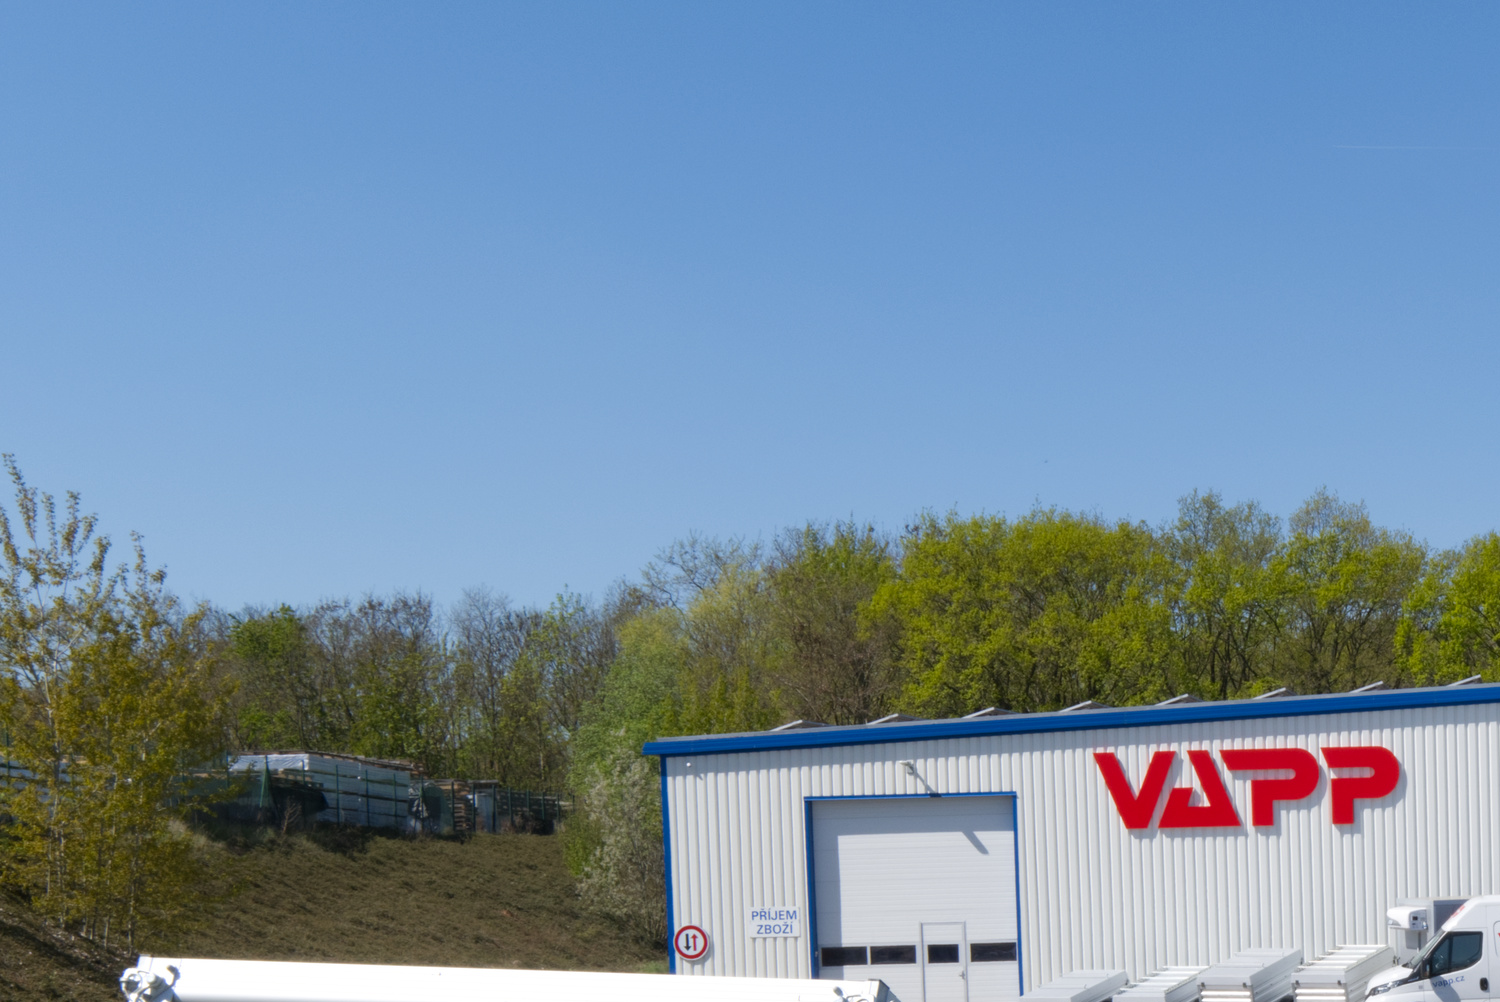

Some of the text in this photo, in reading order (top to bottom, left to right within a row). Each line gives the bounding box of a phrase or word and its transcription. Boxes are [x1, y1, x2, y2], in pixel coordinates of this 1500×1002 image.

[1093, 746, 1399, 830] VAPP
[751, 908, 797, 921] PŘÍJEM
[756, 922, 793, 935] ZBOŽÍ
[1432, 975, 1465, 988] vapp.cz
